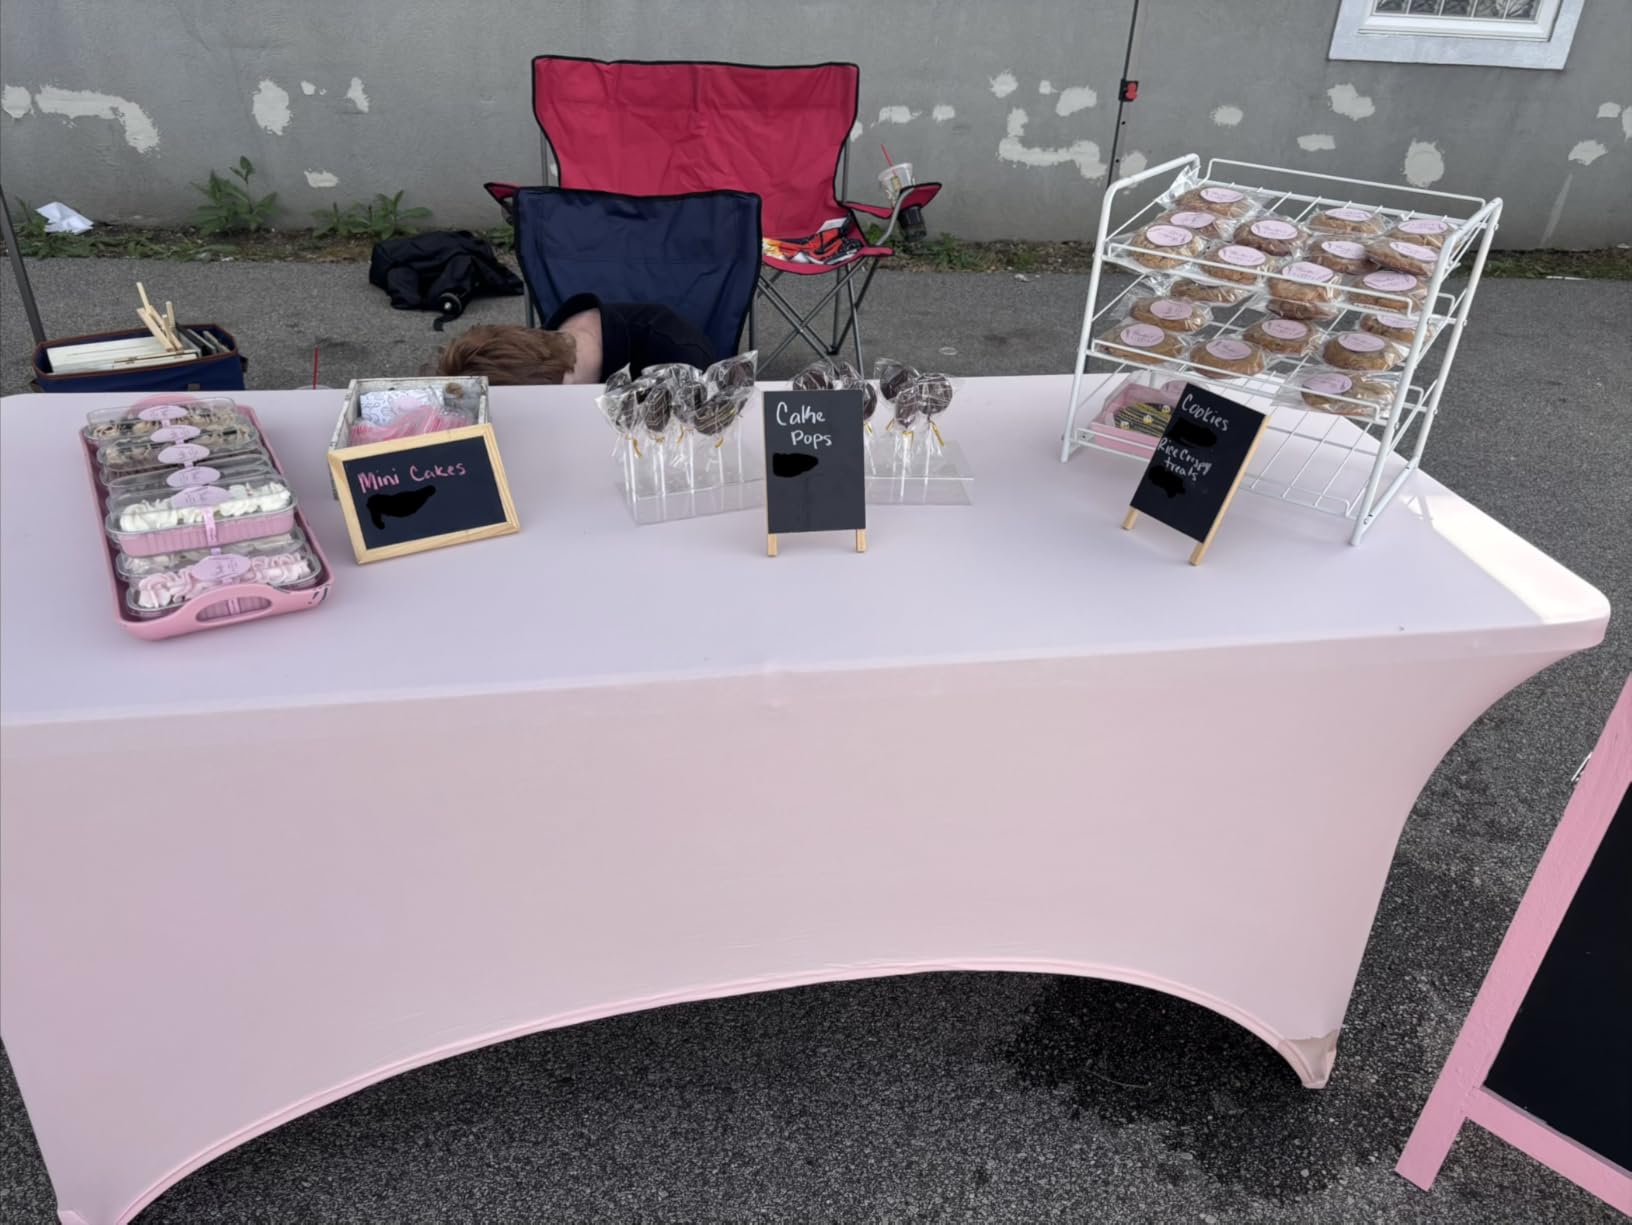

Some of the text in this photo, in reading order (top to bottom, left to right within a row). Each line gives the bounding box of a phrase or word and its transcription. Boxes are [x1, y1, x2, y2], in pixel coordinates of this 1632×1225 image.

[1181, 393, 1230, 431] Cookies
[791, 430, 832, 449] Pops
[358, 463, 466, 493] Mini Cakes
